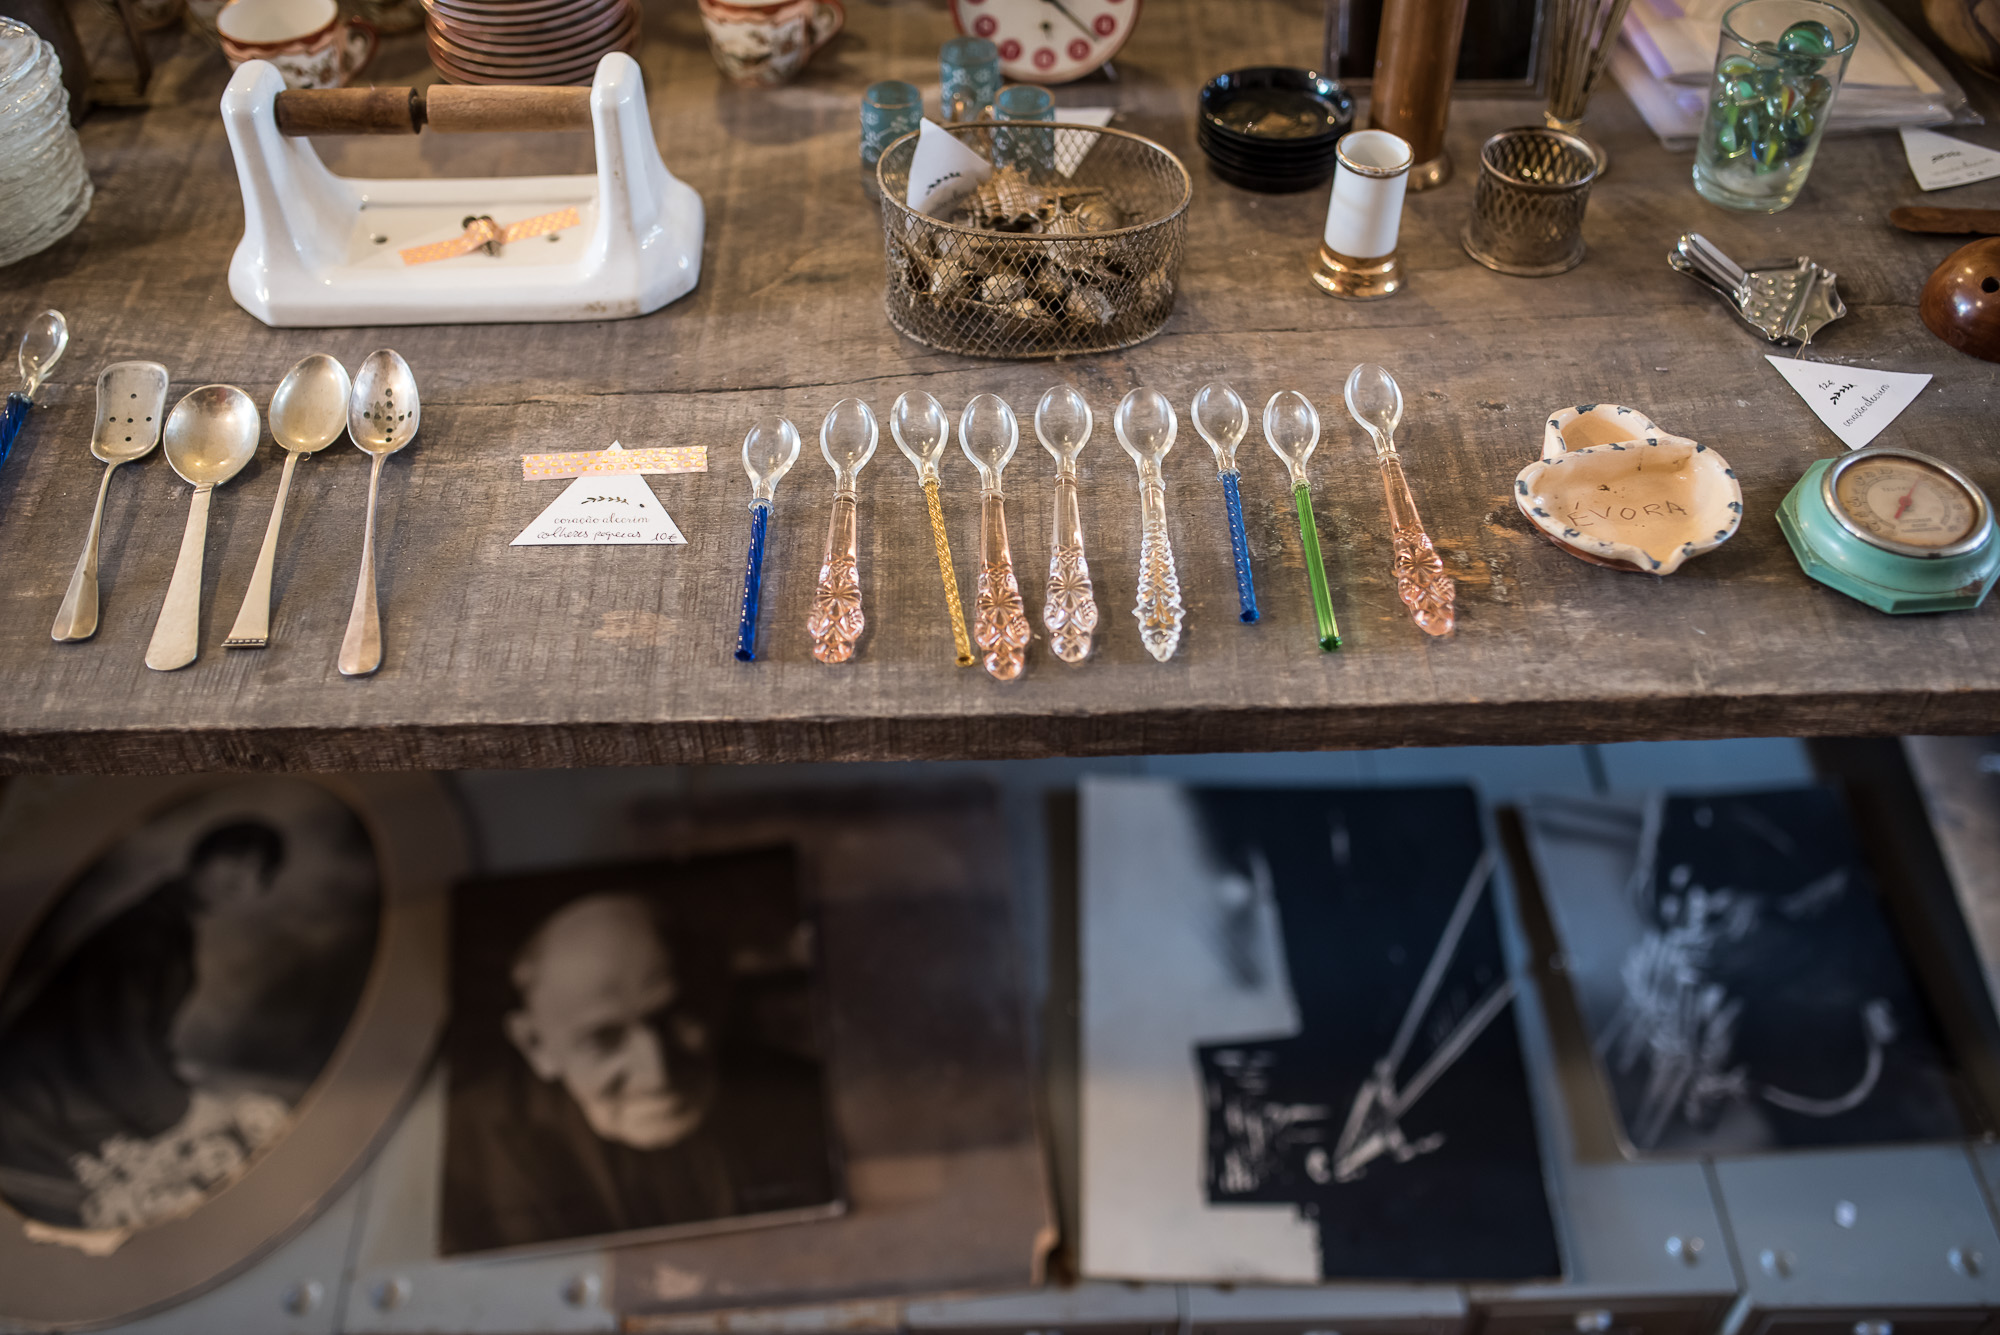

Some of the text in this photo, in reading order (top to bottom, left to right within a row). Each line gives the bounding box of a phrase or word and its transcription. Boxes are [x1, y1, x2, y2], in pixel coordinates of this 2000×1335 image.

[554, 513, 649, 525] coração alecrim
[1567, 500, 1688, 527] ÉVORA
[537, 526, 589, 539] colheres
[651, 532, 678, 543] 10€
